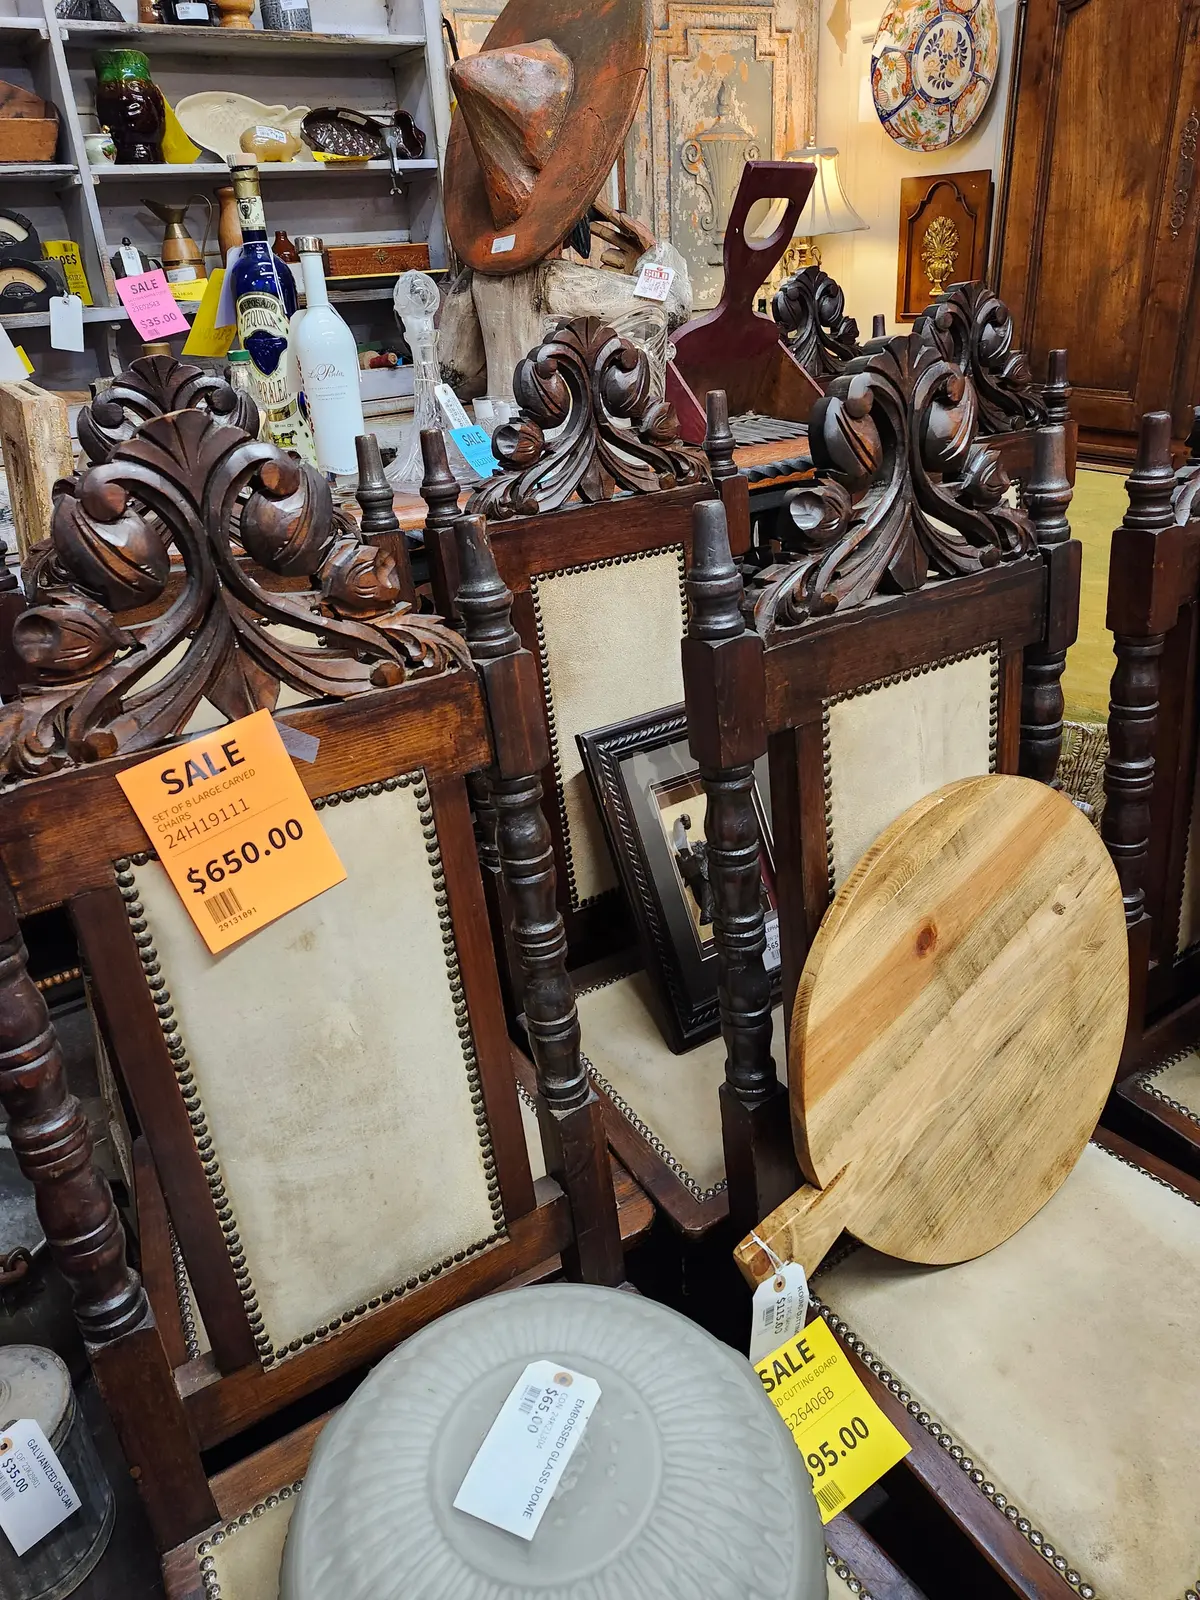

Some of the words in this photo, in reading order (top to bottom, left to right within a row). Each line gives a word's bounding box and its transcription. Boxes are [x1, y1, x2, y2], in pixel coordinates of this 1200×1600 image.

[130, 279, 158, 295] SALE
[140, 312, 177, 329] $35.00
[243, 310, 282, 332] TEQUILA
[462, 431, 486, 447] SALE
[160, 739, 246, 795] SALE
[152, 809, 170, 824] SET
[171, 802, 184, 815] OF
[185, 799, 192, 808] 8
[192, 785, 222, 805] LARGE
[222, 768, 256, 790] CARVED
[157, 811, 192, 833] CHAIRS
[163, 798, 250, 849] 24H19111
[187, 819, 303, 895] $650.00
[774, 1297, 786, 1335] $115.00
[797, 1285, 805, 1310] ROUND
[758, 1338, 816, 1393] SALE
[784, 1374, 815, 1402] CUTTING
[814, 1355, 838, 1382] BOARD
[527, 1387, 559, 1434] $65.00
[555, 1392, 569, 1410] CON
[783, 1385, 835, 1432] G26406B
[555, 1398, 585, 1449] EMBOSSED
[14, 1449, 26, 1462] LOF
[538, 1450, 560, 1485] GLASS
[807, 1416, 869, 1488] 95.00
[2, 1457, 28, 1493] $35.00
[27, 1438, 58, 1483] GALVANIZED
[53, 1481, 66, 1497] GAS
[61, 1494, 74, 1510] CAN
[522, 1485, 544, 1520] DOME
